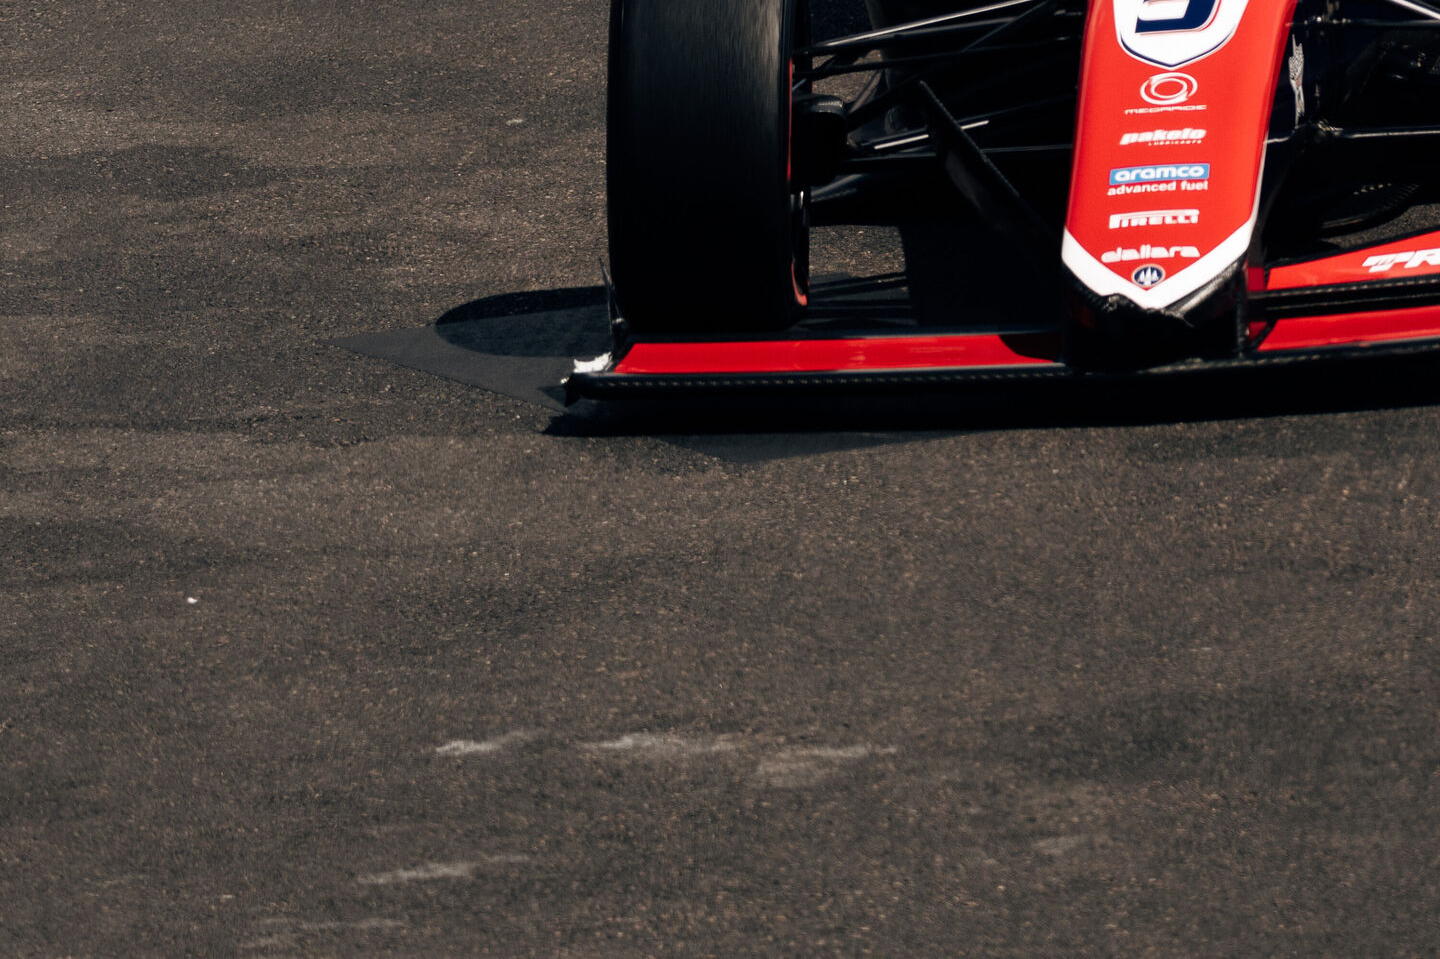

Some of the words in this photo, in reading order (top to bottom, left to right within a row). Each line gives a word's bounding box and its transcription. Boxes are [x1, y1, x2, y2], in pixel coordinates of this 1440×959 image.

[1124, 104, 1207, 115] MEGARIDE
[1119, 127, 1207, 146] pakelo
[1114, 166, 1205, 182] aramco
[1107, 181, 1177, 196] advanced
[1181, 180, 1209, 191] fuel
[1108, 208, 1200, 229] PIRELLI
[1100, 244, 1201, 264] dallara
